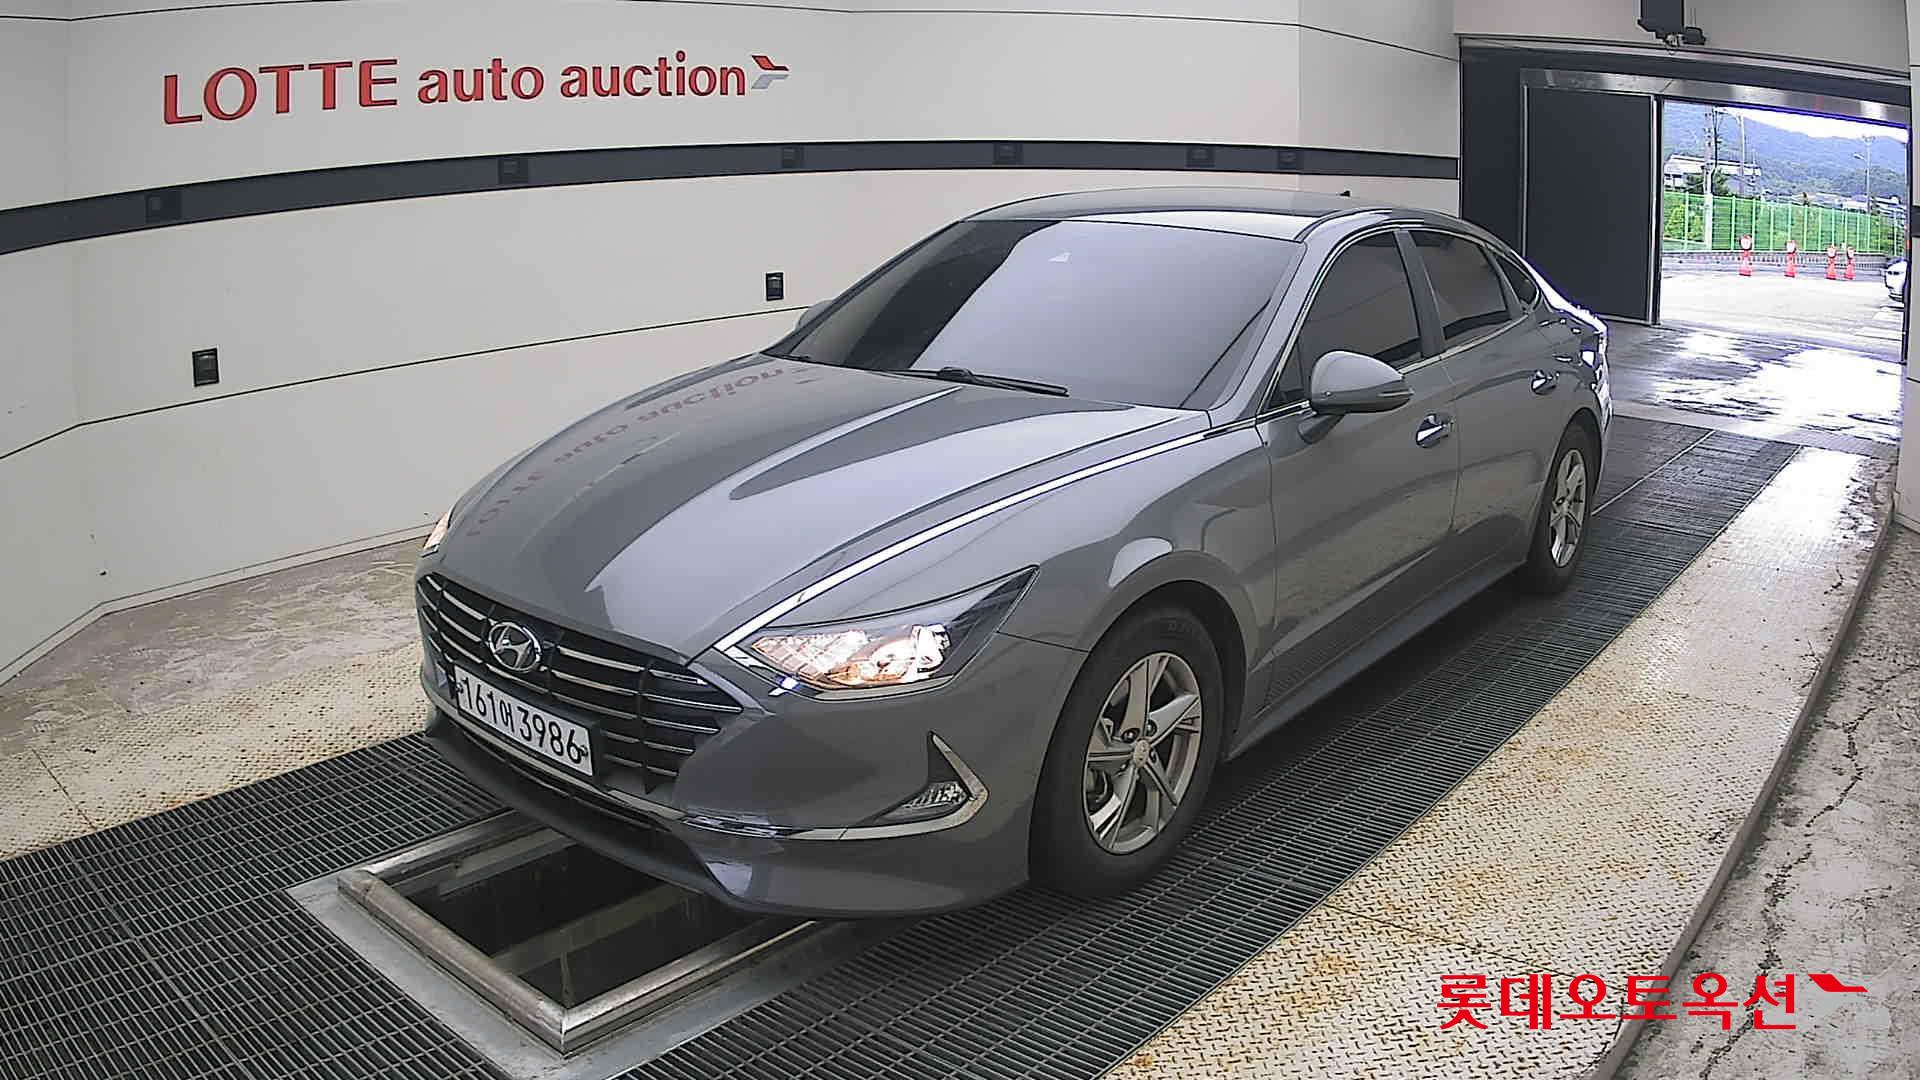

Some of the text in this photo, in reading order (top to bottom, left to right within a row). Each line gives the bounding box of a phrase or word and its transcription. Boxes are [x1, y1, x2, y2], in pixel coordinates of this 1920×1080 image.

[163, 50, 747, 125] LOTTE auto auction
